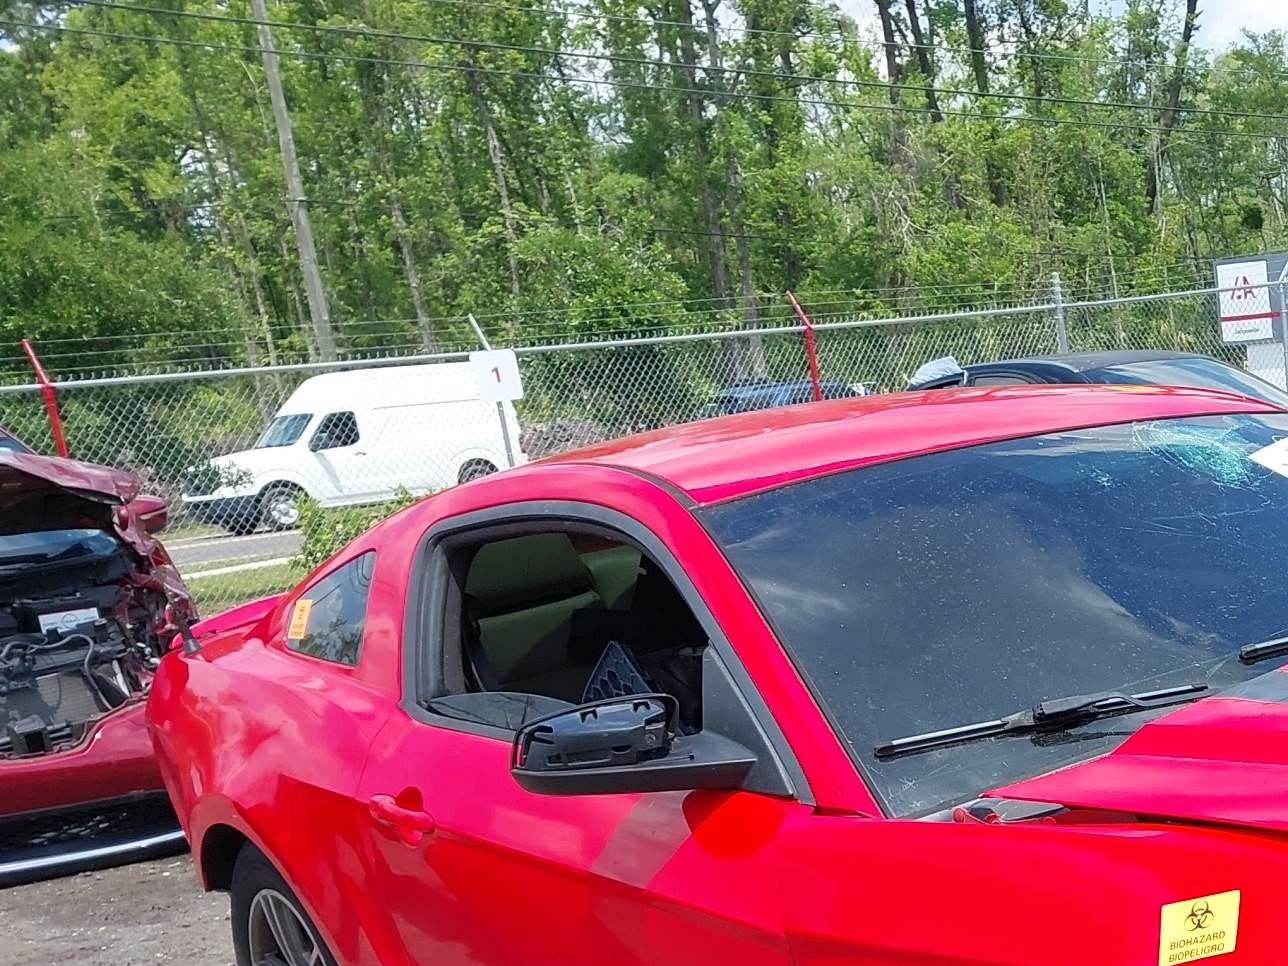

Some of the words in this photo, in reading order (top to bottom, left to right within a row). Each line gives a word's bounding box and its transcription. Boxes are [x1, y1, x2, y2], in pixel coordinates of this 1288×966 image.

[491, 366, 501, 383] 1
[1169, 930, 1226, 951] BIOHAZARD
[1168, 942, 1225, 963] BIOPELIGRO
